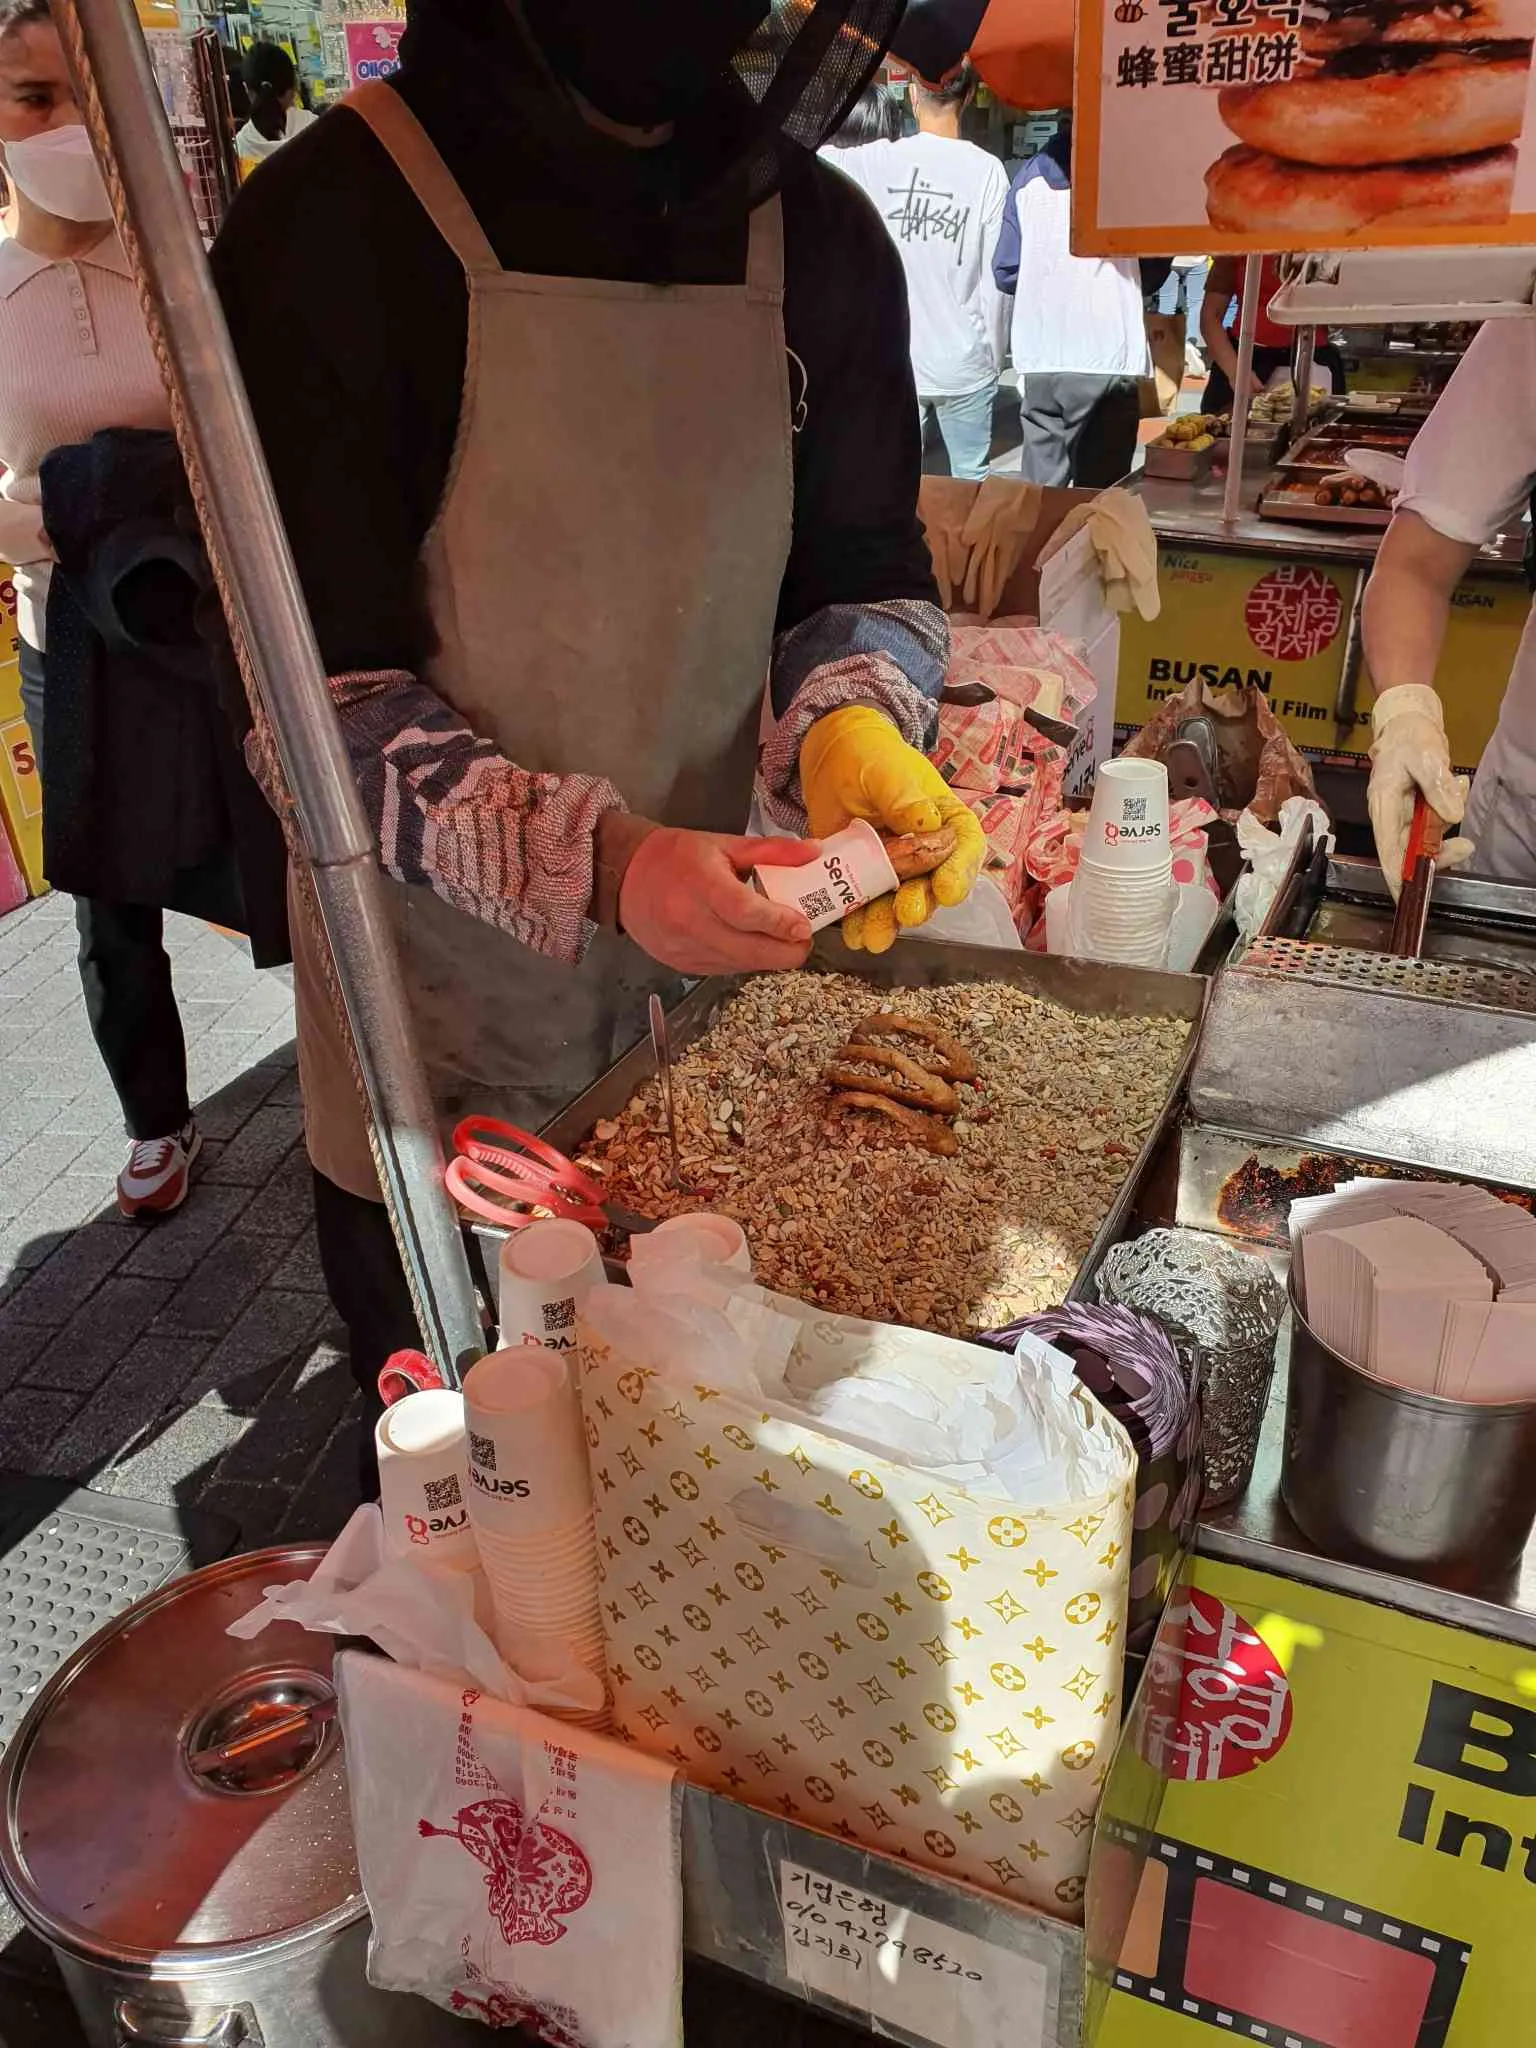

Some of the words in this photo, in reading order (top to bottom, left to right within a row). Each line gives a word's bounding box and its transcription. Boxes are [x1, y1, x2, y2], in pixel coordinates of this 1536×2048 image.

[1116, 33, 1298, 88] 蜂蜜甜饼
[1149, 658, 1273, 694] BUSAN
[1282, 699, 1328, 721] Film
[790, 1872, 888, 1927] 기업은행
